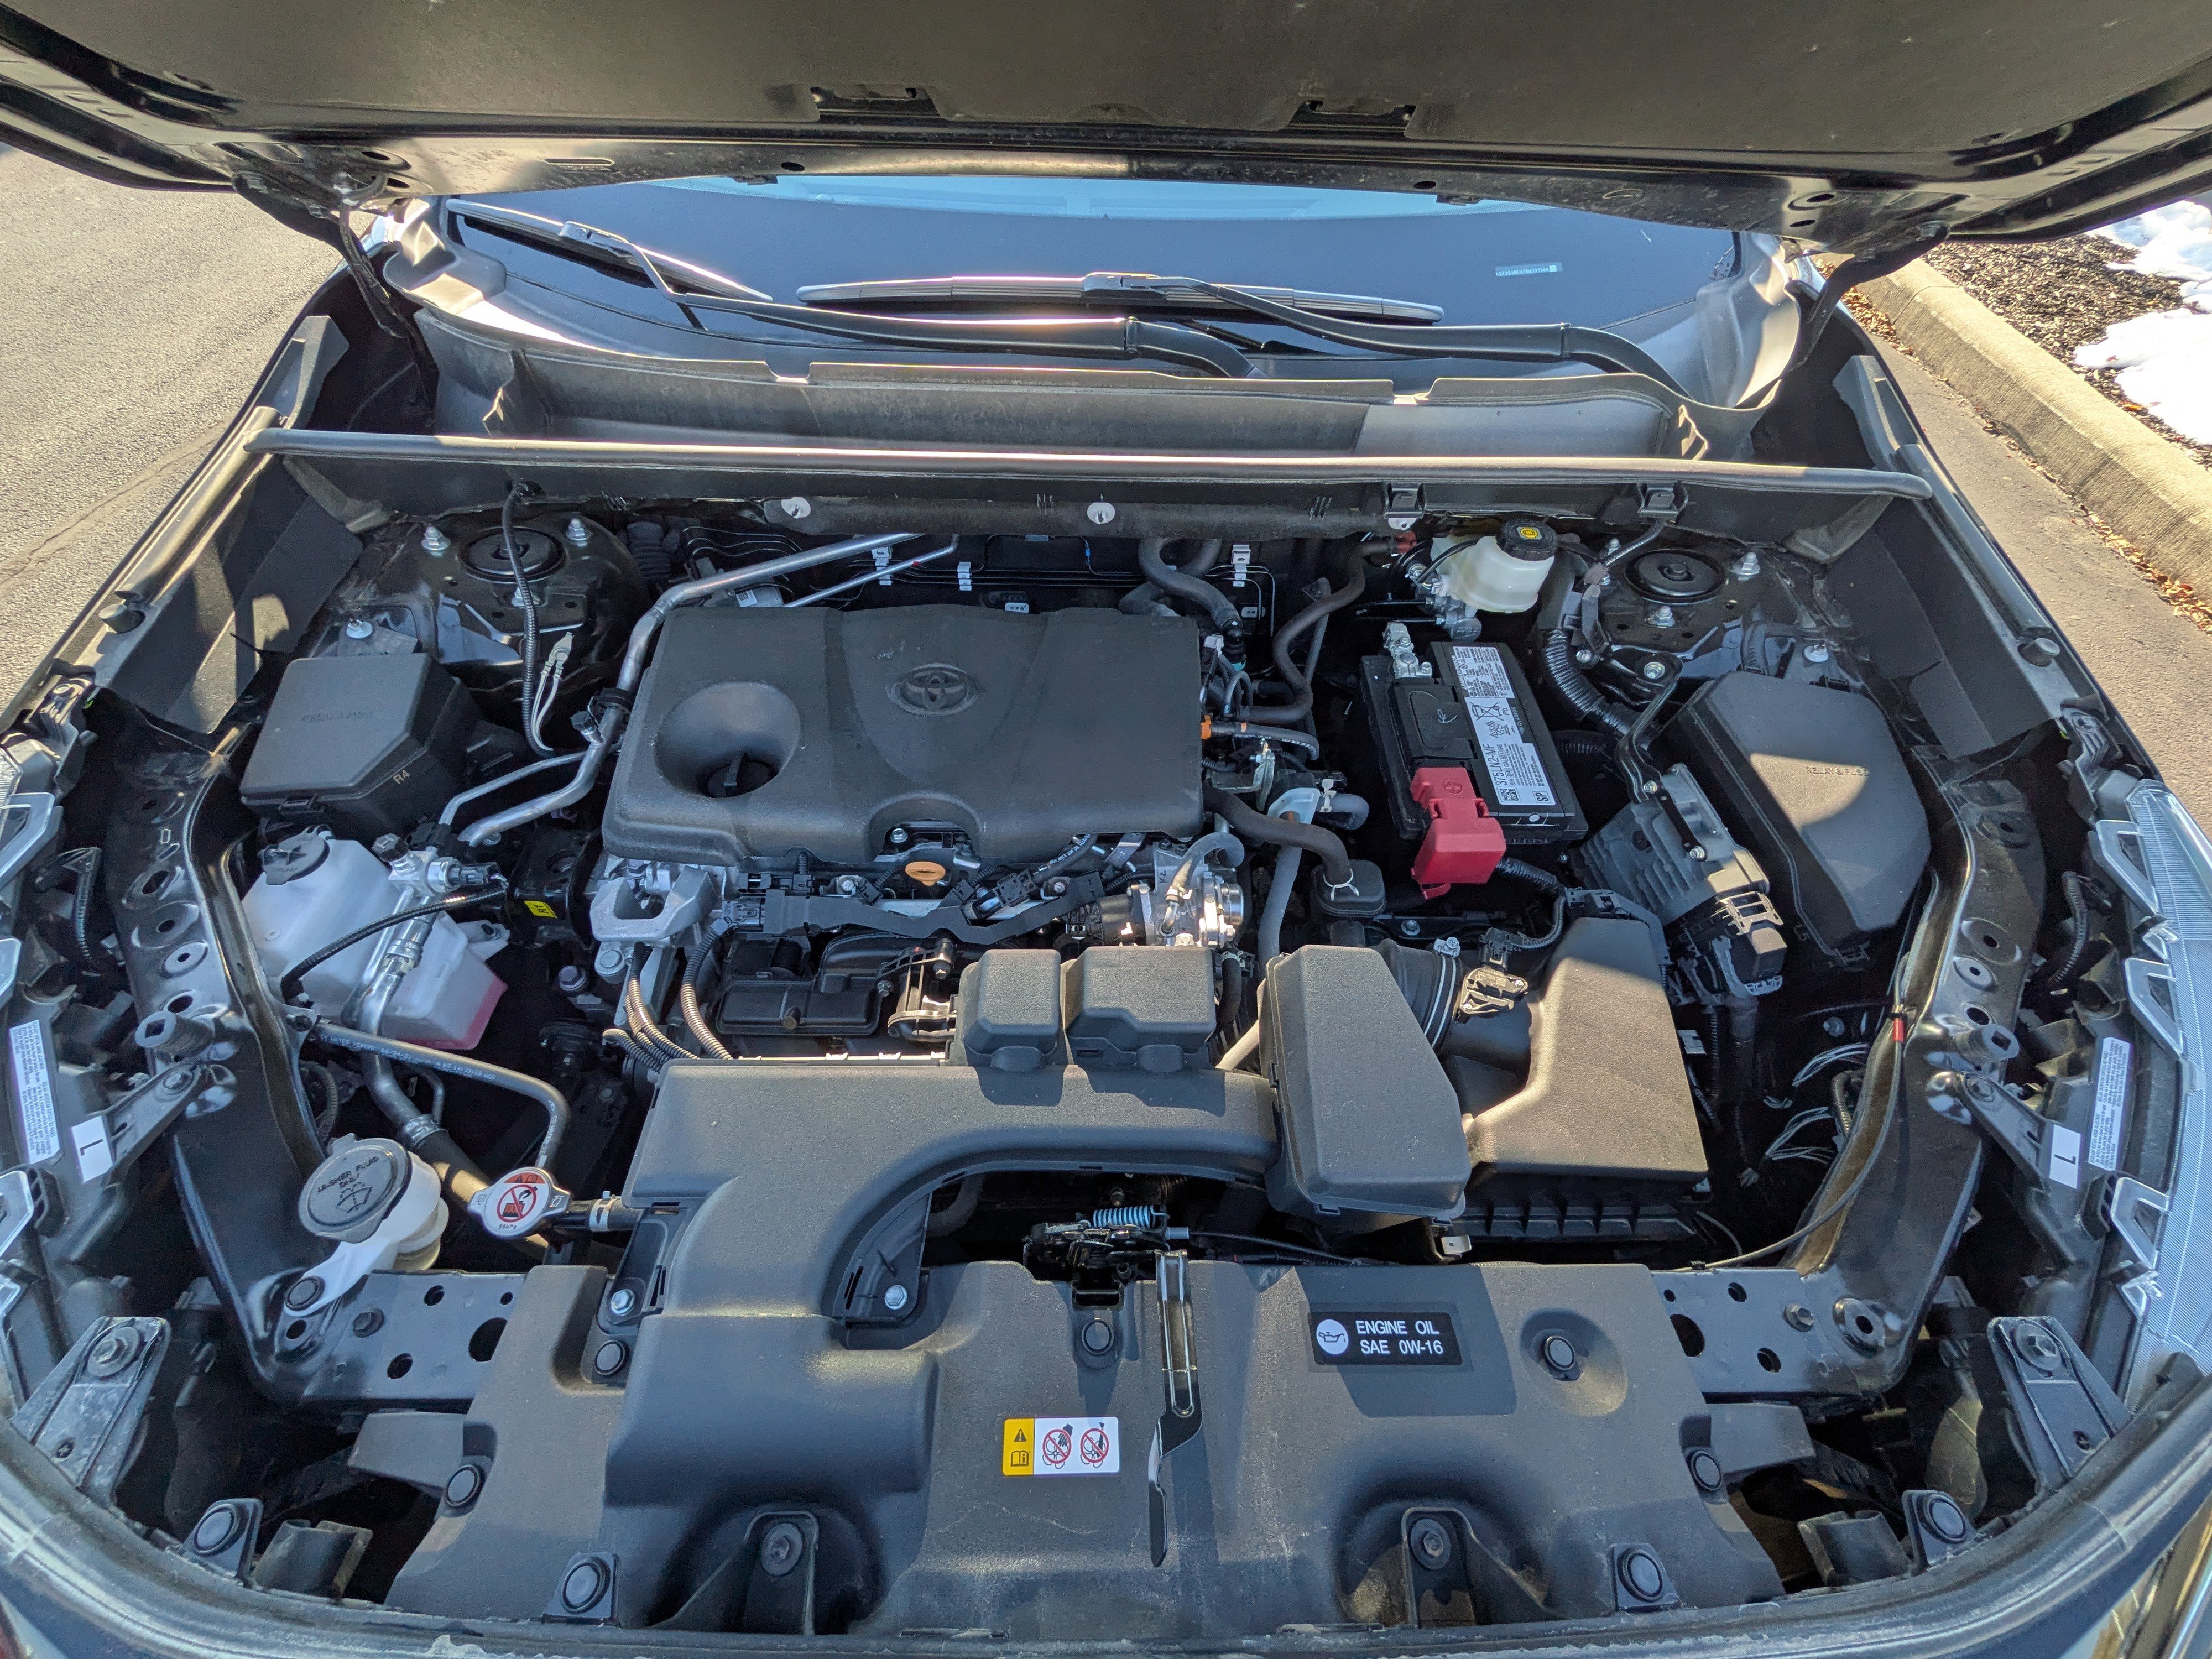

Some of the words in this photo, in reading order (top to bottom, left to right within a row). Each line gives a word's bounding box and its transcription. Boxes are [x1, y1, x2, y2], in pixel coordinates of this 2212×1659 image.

[1511, 707, 1522, 726] CLARIOS
[1483, 744, 1507, 785] 375LN2-MF
[393, 769, 410, 784] R4
[1535, 792, 1548, 801] SP
[534, 904, 549, 914] R1
[355, 1156, 379, 1172] FLUID
[1355, 1320, 1408, 1335] ENGINE
[1415, 1320, 1439, 1335] OIL
[1360, 1339, 1390, 1354] SAE
[1399, 1339, 1444, 1354] 0W-16
